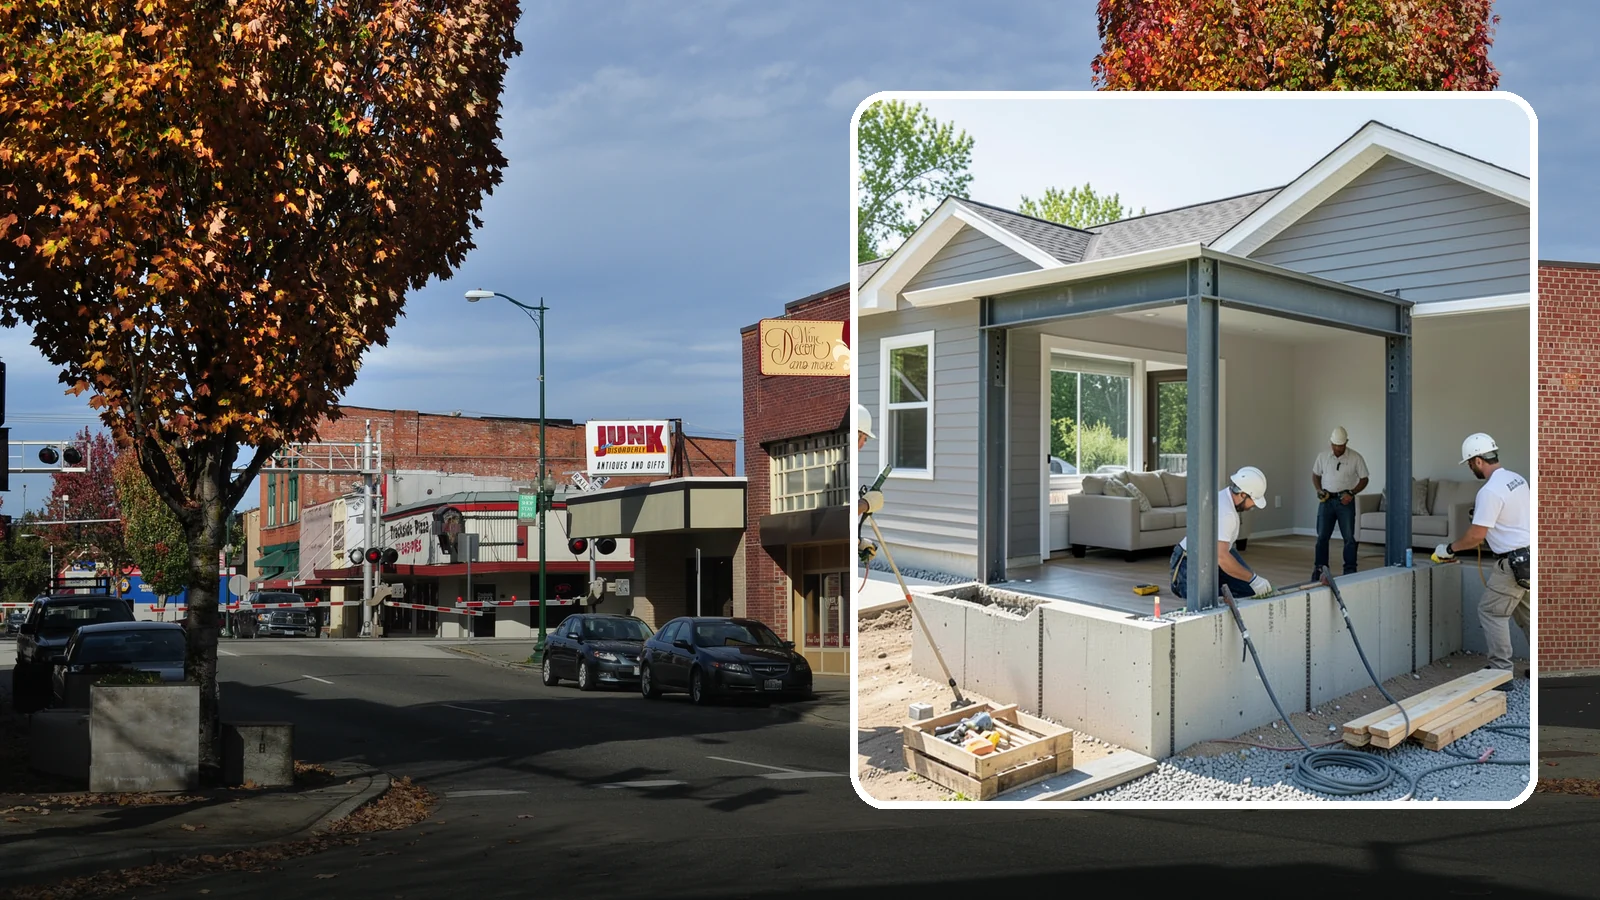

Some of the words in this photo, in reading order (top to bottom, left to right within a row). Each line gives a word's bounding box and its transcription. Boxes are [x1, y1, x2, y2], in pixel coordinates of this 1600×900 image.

[595, 425, 665, 457] JUNK
[607, 446, 645, 454] DISORDERLY
[596, 461, 628, 470] ANTIQUES
[631, 461, 644, 470] AND
[646, 460, 665, 469] GIFTS
[390, 522, 413, 540] Trackside
[414, 519, 429, 535] Pizza
